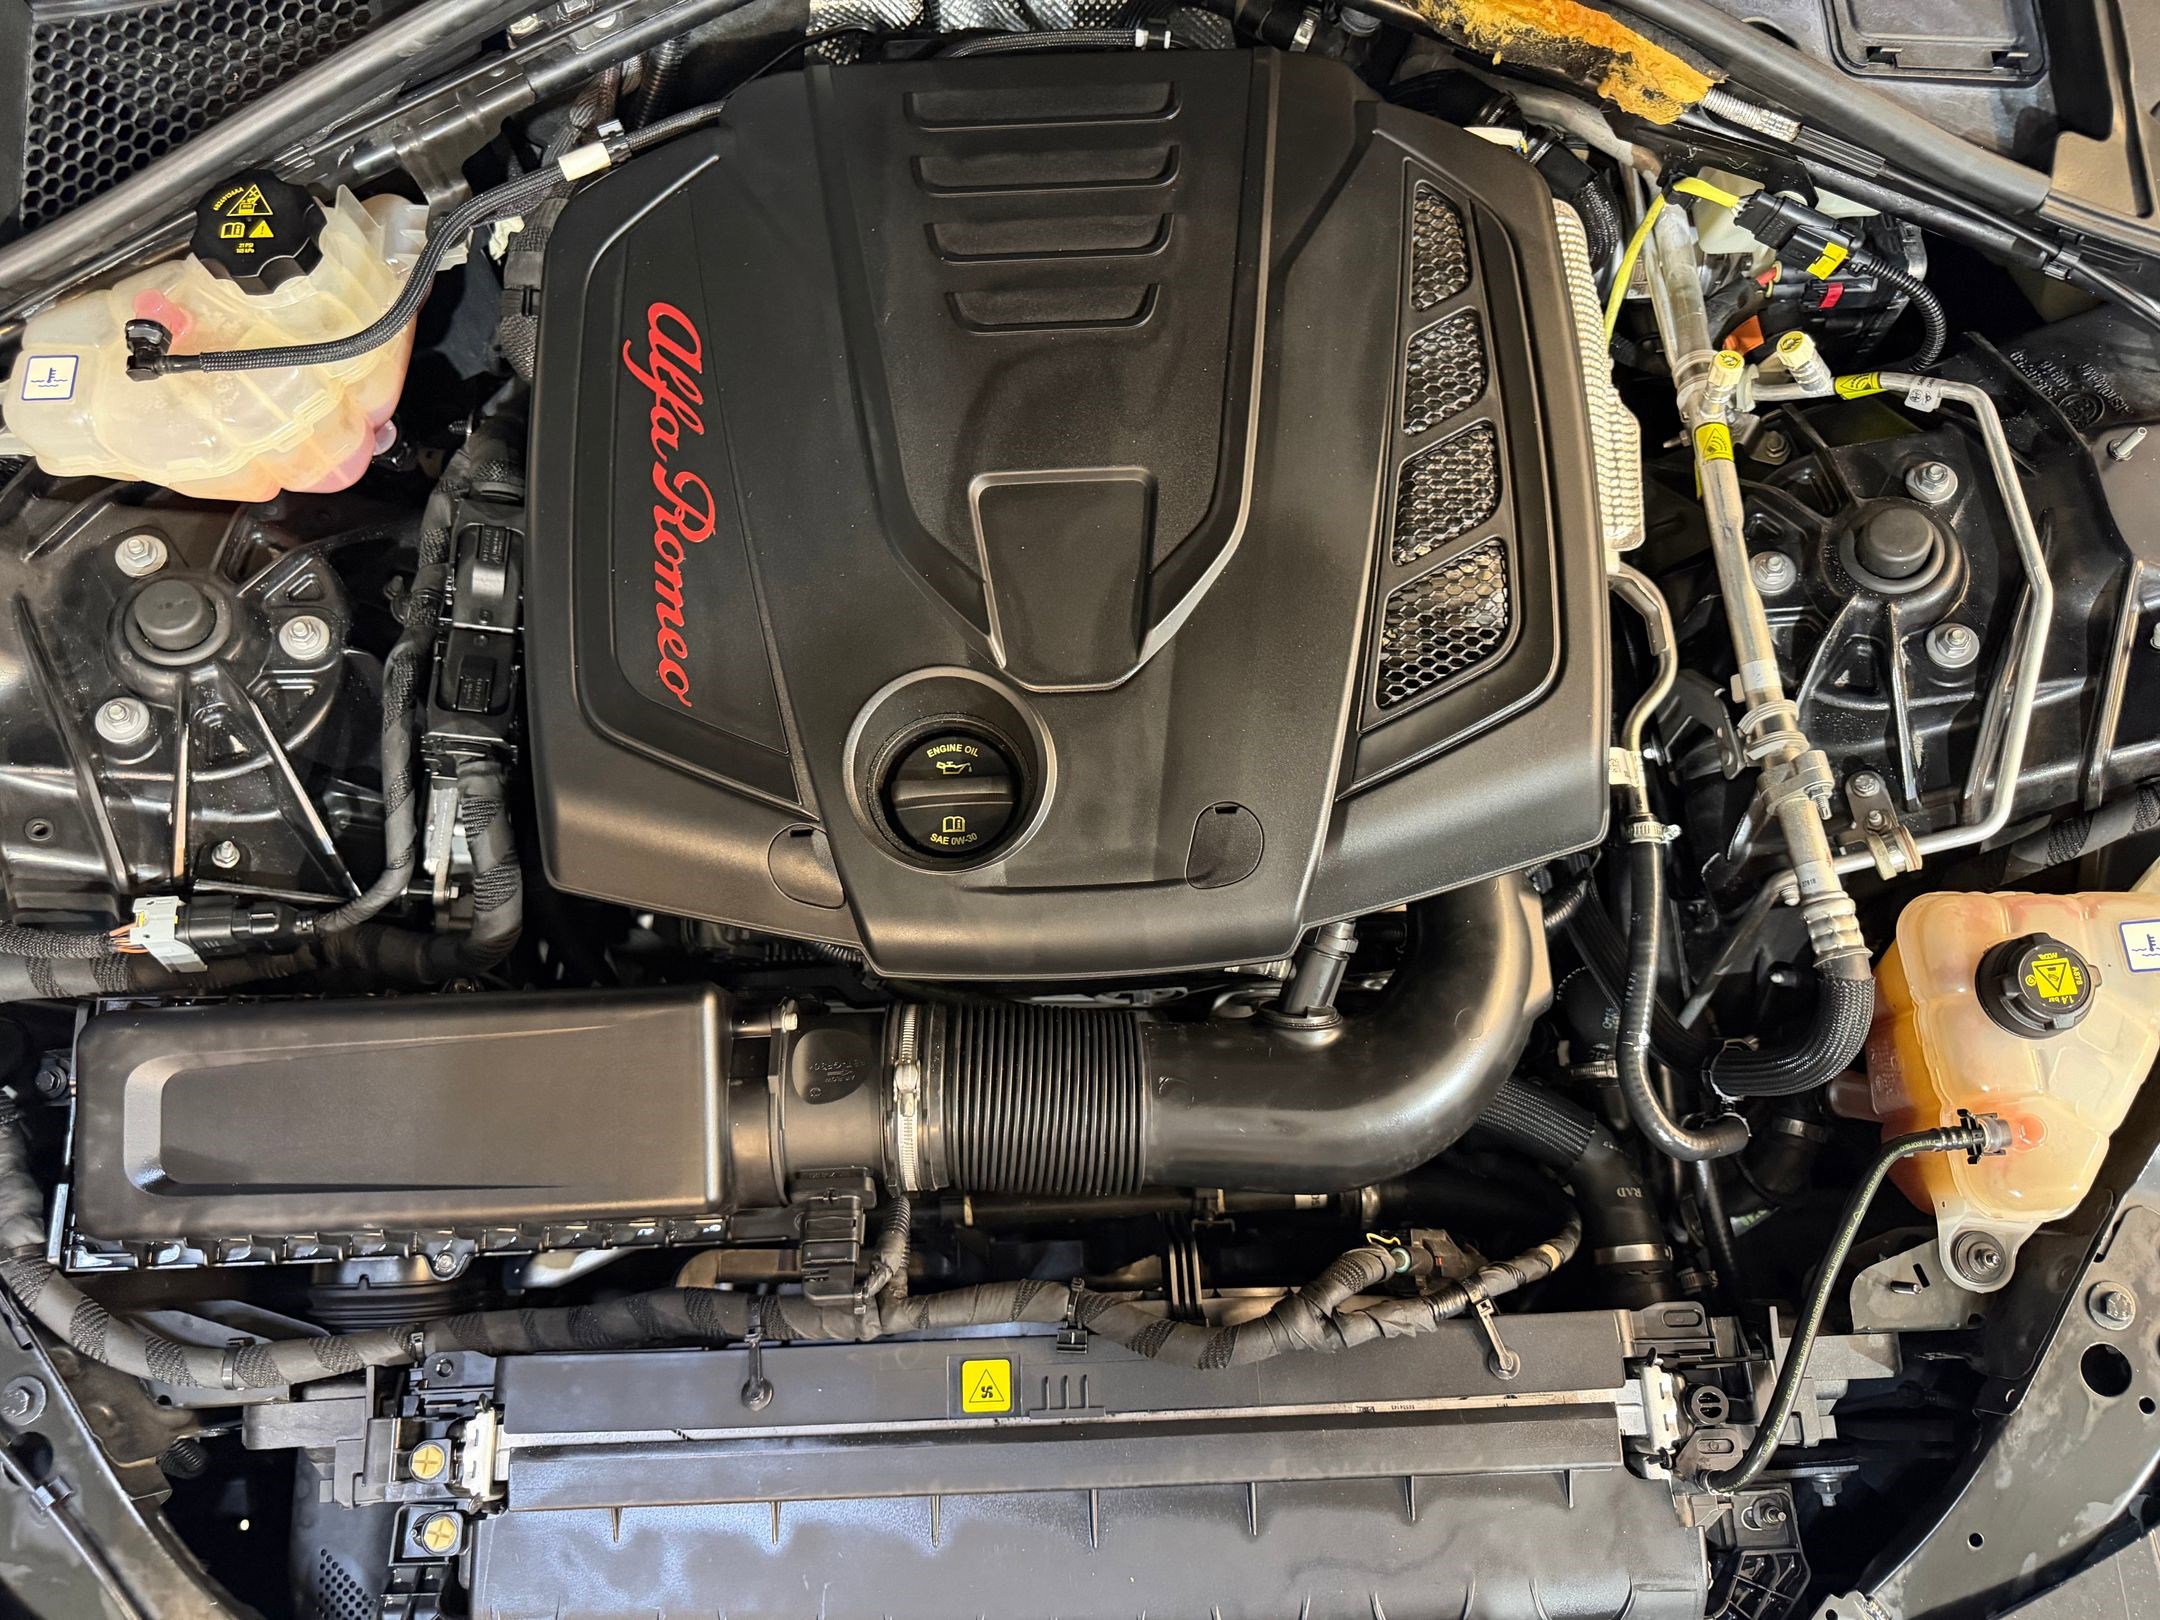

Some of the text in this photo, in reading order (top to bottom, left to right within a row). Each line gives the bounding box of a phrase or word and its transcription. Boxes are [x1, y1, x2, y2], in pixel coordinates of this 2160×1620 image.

[622, 302, 717, 707] Alfa Romeo
[926, 743, 980, 758] ENGINE OIL
[930, 832, 978, 846] SAE 0W-30
[2061, 995, 2074, 1005] 1.4
[1616, 1187, 1643, 1198] RAD
